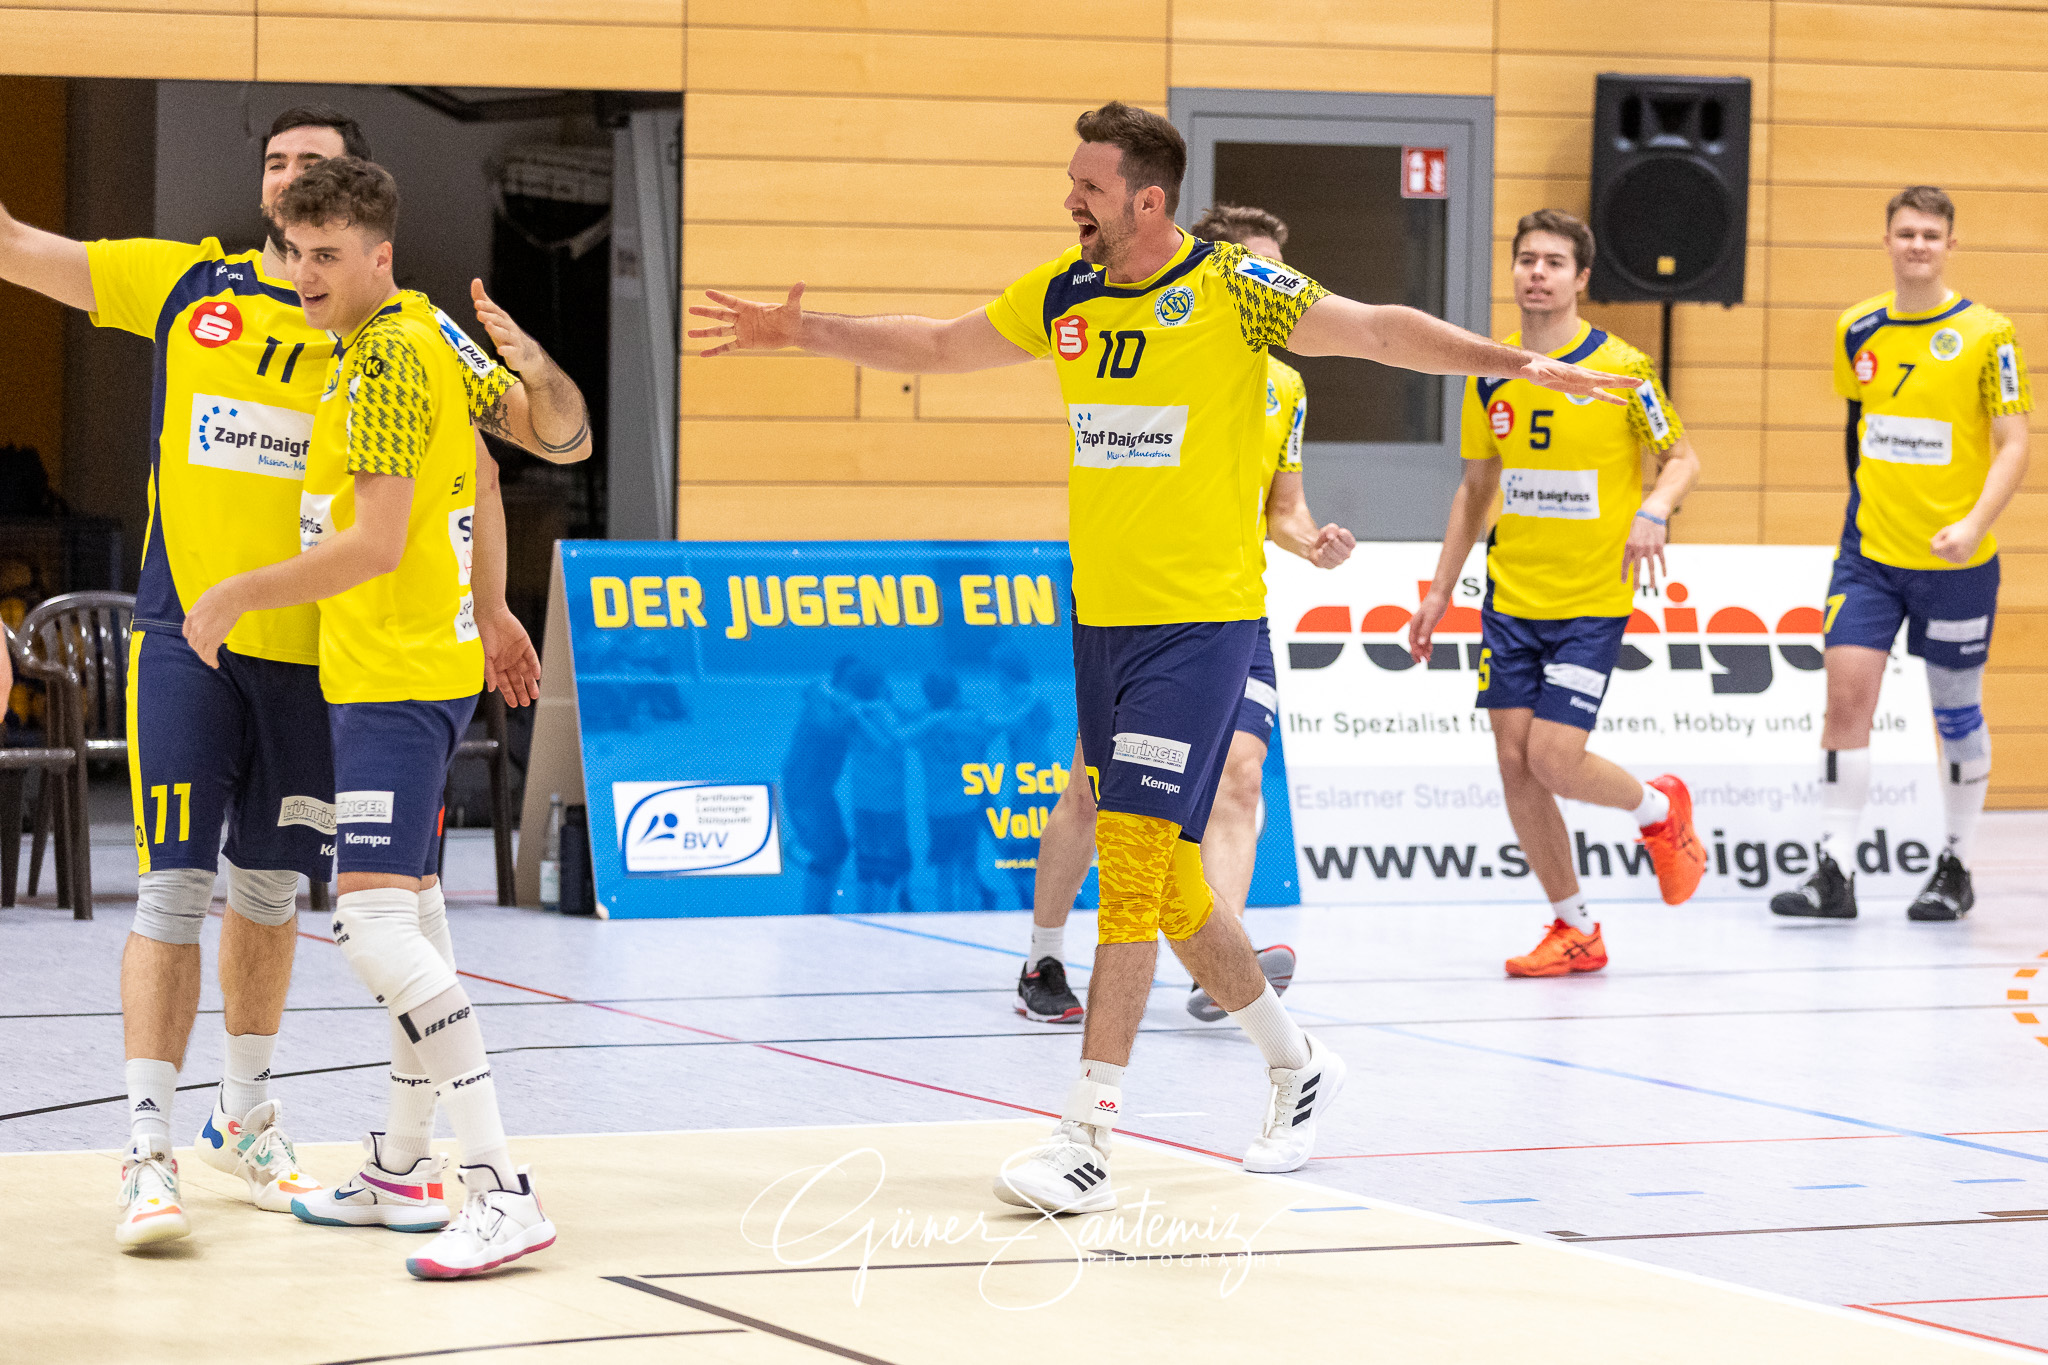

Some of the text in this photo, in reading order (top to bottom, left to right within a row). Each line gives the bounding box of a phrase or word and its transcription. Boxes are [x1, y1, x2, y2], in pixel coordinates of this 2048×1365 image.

[256, 335, 306, 384] 11
[1096, 330, 1147, 379] 10
[1892, 362, 1917, 398] 7
[214, 426, 257, 449] Zapf
[1108, 431, 1173, 448] Daigfuss
[1529, 410, 1554, 450] 5
[590, 574, 1059, 641] DER JUGEND EIN
[1289, 713, 1323, 733] Ihr
[1334, 711, 1461, 741] Spezialist
[1674, 711, 1756, 741] Hobby
[1765, 712, 1812, 732] und
[961, 762, 1005, 796] SV
[1140, 774, 1181, 794] Kempa
[1295, 783, 1500, 810] Eslarner Straße
[150, 782, 192, 845] 11
[345, 832, 391, 848] Kempa
[683, 831, 729, 849] BVV
